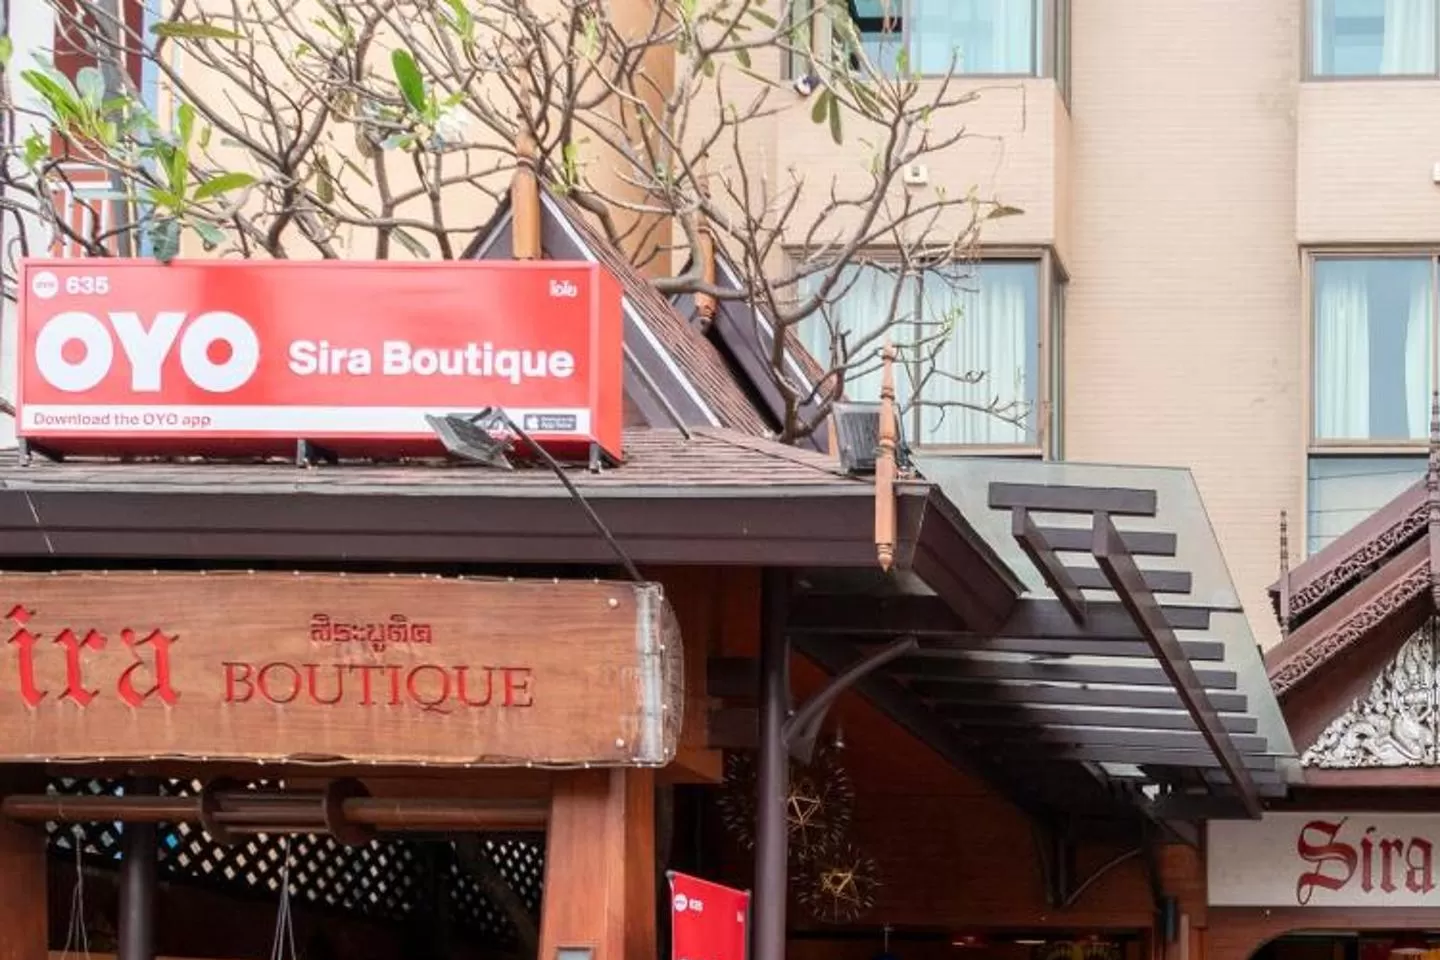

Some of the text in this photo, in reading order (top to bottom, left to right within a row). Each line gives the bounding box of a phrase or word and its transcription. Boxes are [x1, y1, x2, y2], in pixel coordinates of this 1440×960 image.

[65, 275, 109, 295] 635
[35, 311, 260, 393] OYO
[289, 340, 576, 385] Sira Boutique
[33, 411, 211, 429] Download the OYO app
[4, 604, 183, 707] ira
[222, 661, 533, 715] BOUTIQUE
[1297, 815, 1436, 905] Sira
